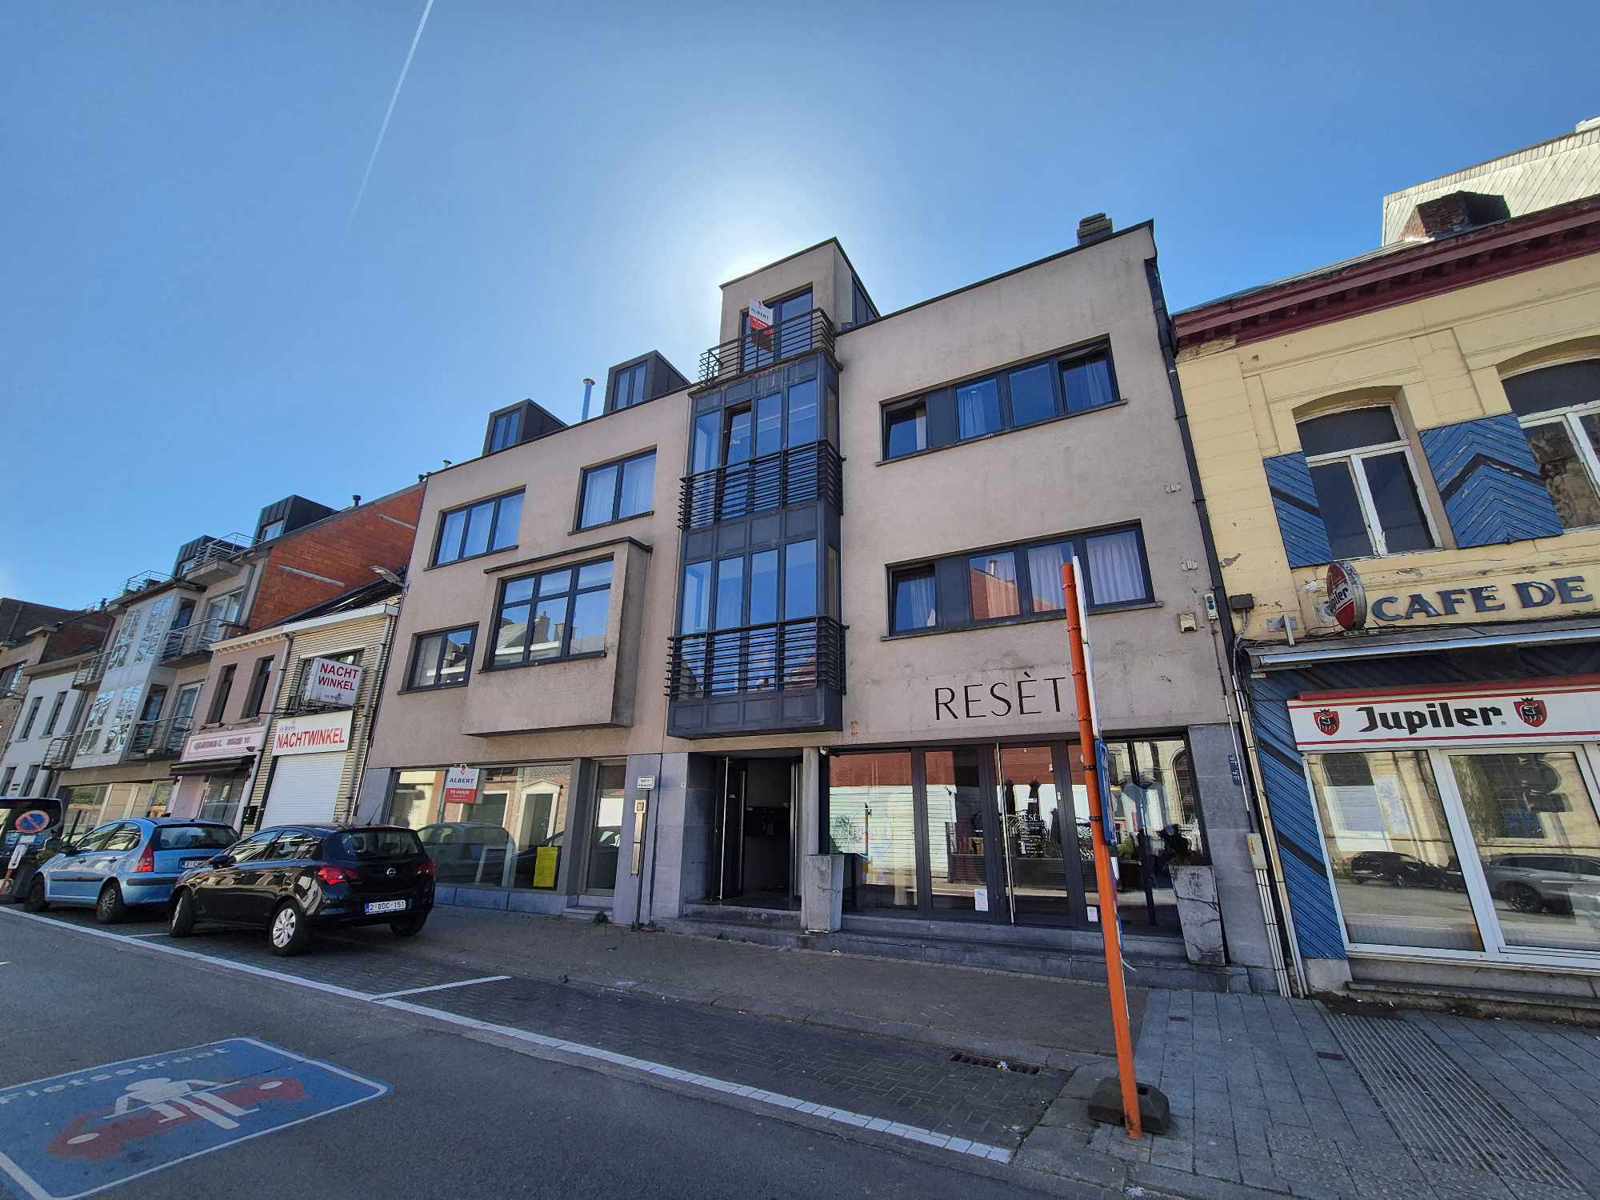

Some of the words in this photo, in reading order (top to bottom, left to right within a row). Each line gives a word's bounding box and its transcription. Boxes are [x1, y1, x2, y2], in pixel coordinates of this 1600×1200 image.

[1371, 585, 1505, 621] CAFE
[1512, 576, 1593, 609] DE
[318, 676, 355, 691] WINKEL
[320, 663, 359, 680] NACHT
[934, 671, 1066, 721] RESÈT
[1356, 702, 1503, 735] Jupiler
[276, 728, 344, 748] NACHTWINKEL
